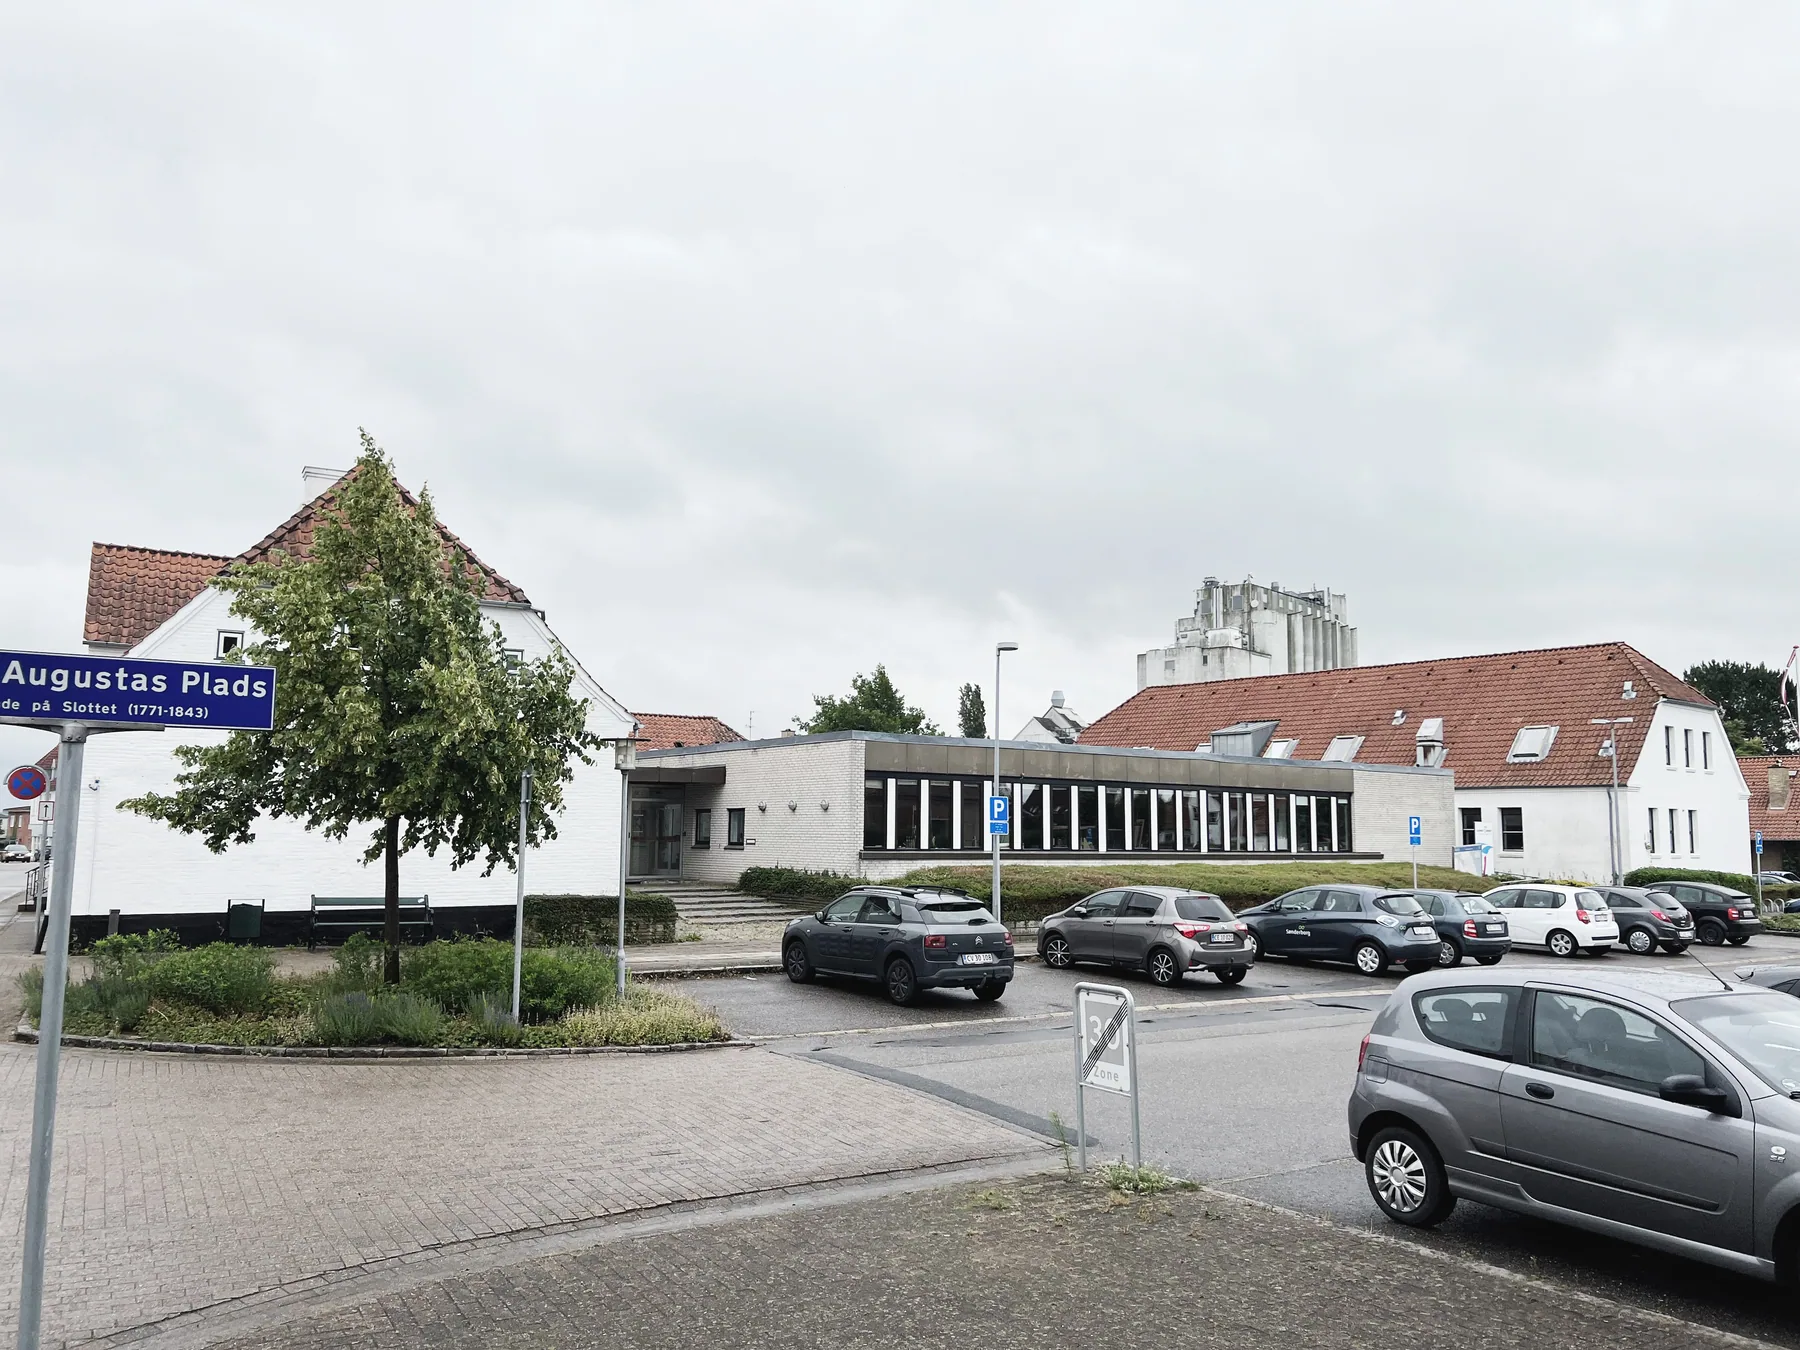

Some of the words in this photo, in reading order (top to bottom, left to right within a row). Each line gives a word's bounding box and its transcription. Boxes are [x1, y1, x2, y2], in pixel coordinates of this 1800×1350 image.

[2, 660, 167, 692] Augustas
[182, 671, 267, 697] Plads
[1, 698, 20, 710] de
[32, 700, 51, 713] på
[63, 701, 117, 714] Slottet
[128, 704, 209, 719] (1771-1843)
[994, 800, 1005, 818] P
[1412, 818, 1419, 833] P
[1088, 1015, 1120, 1050] 30
[1093, 1065, 1119, 1082] Zone
